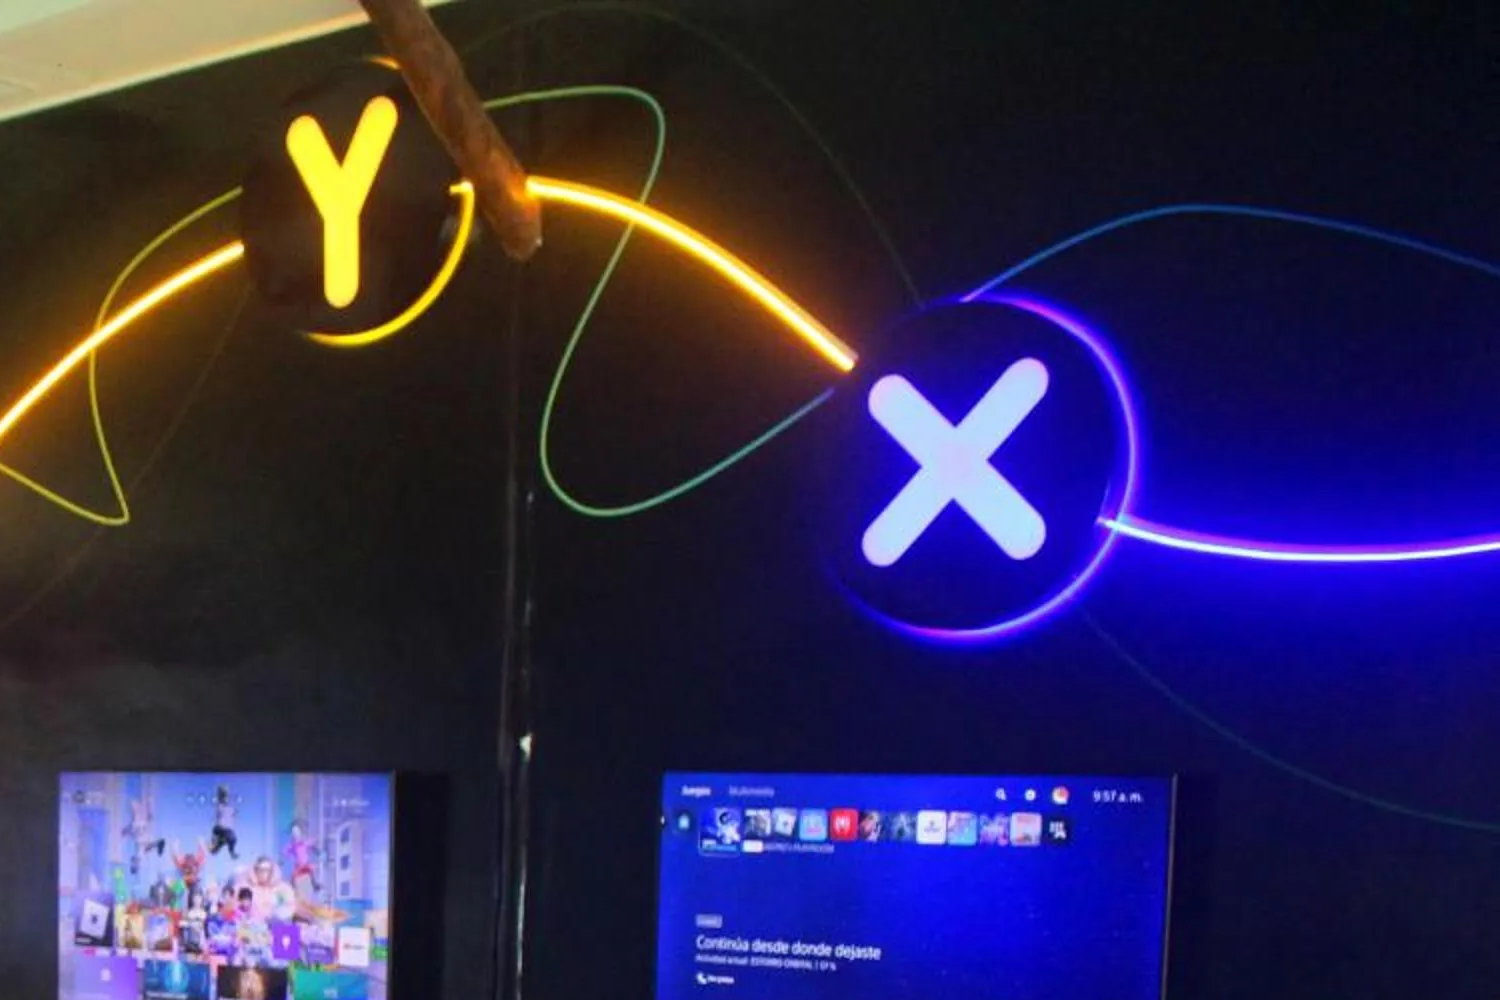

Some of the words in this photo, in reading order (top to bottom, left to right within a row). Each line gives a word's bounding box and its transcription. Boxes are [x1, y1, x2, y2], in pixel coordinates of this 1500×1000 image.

[286, 96, 398, 307] Y
[862, 357, 1049, 567] X
[751, 938, 789, 954] desde
[791, 941, 832, 957] donde
[835, 944, 881, 961] dejaste
